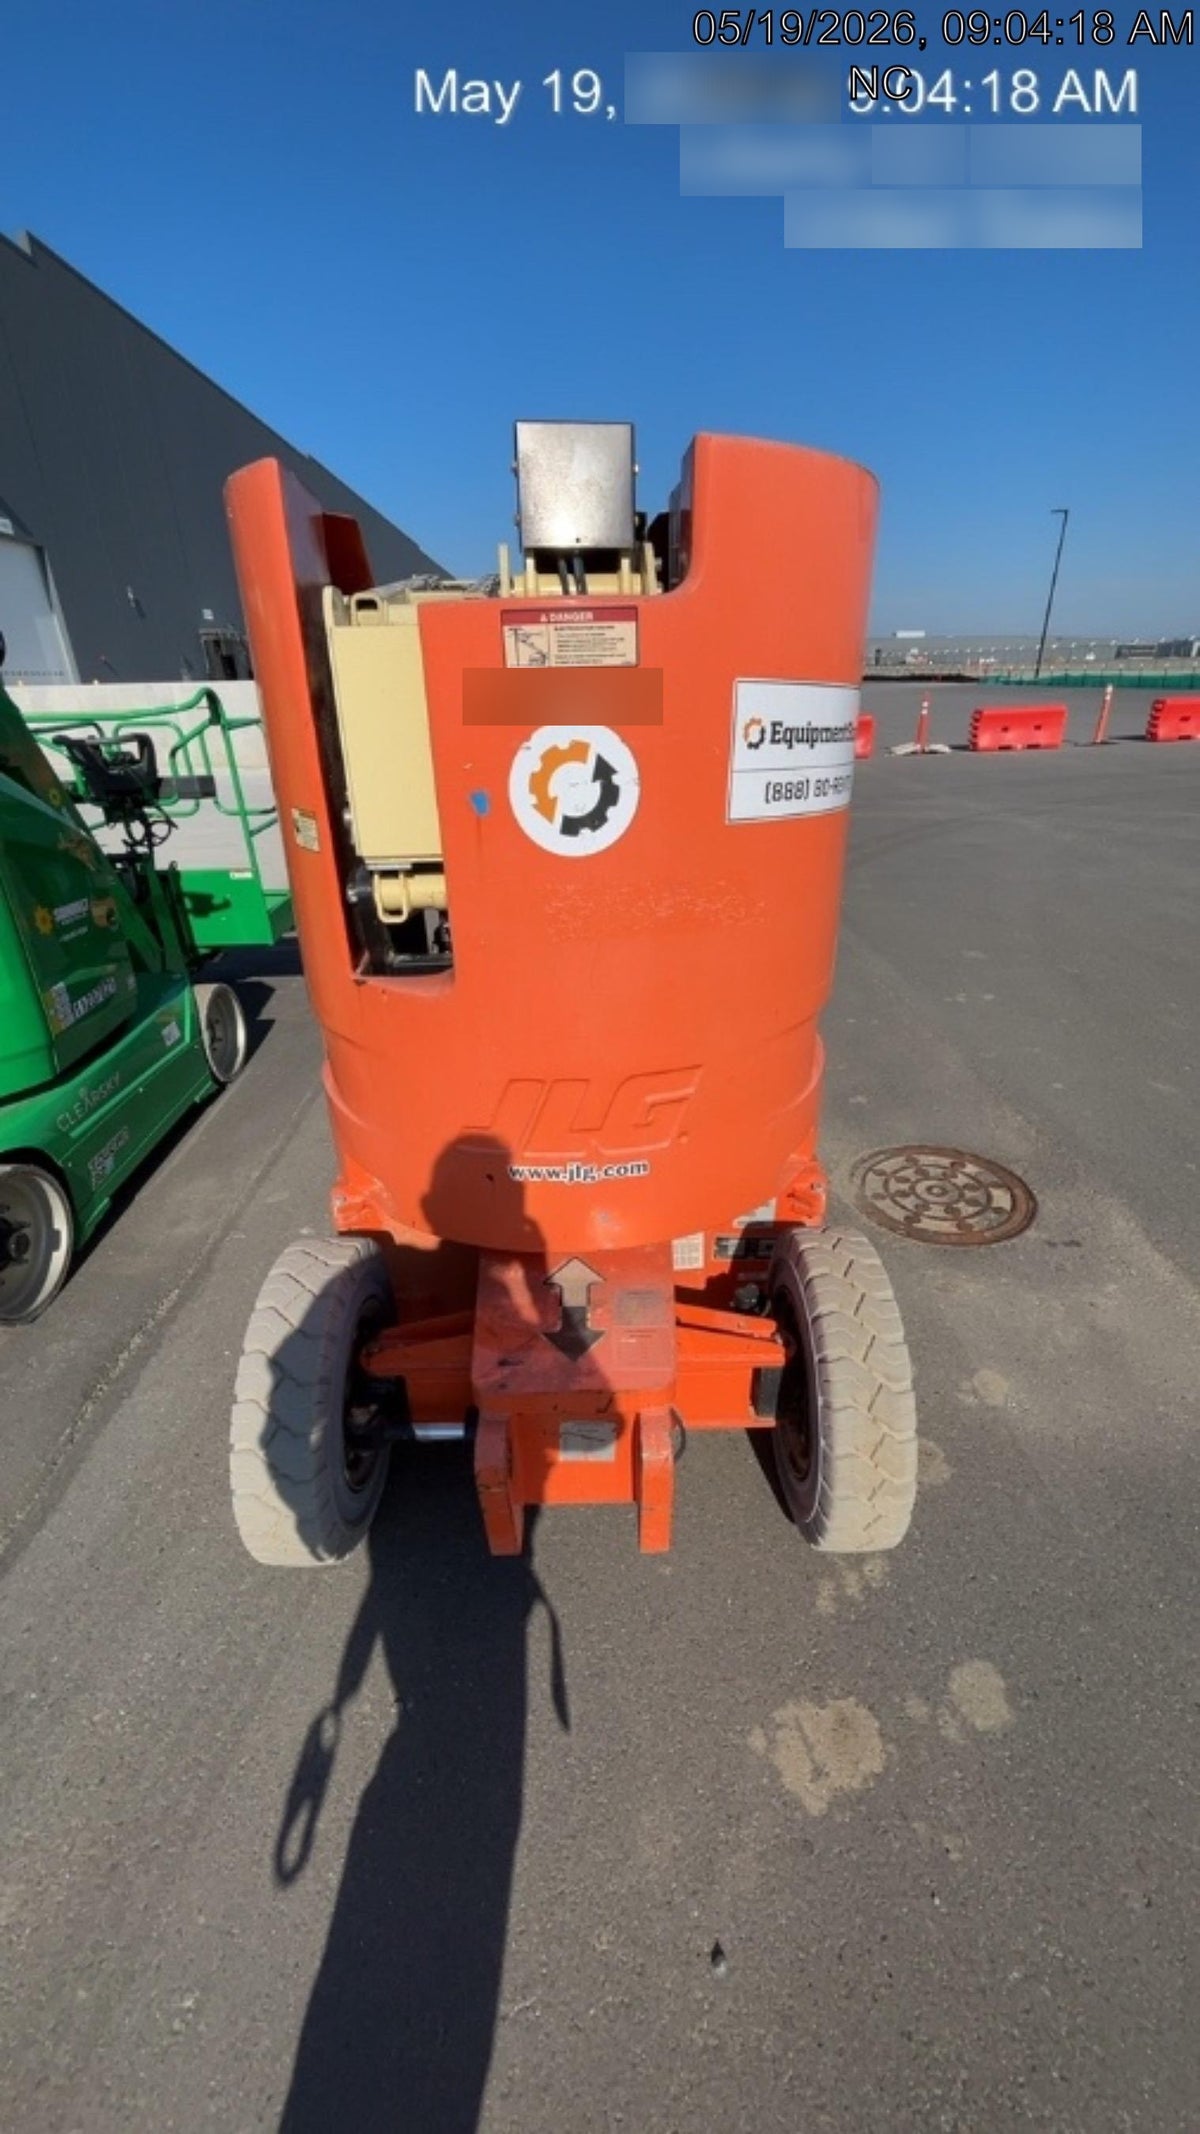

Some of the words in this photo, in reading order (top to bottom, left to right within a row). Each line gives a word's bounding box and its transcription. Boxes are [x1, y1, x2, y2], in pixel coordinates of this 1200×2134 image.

[551, 611, 594, 622] DANGER
[764, 778, 809, 804] (888)
[452, 1064, 703, 1157] JLG
[508, 1160, 650, 1182] www.jlg.com
